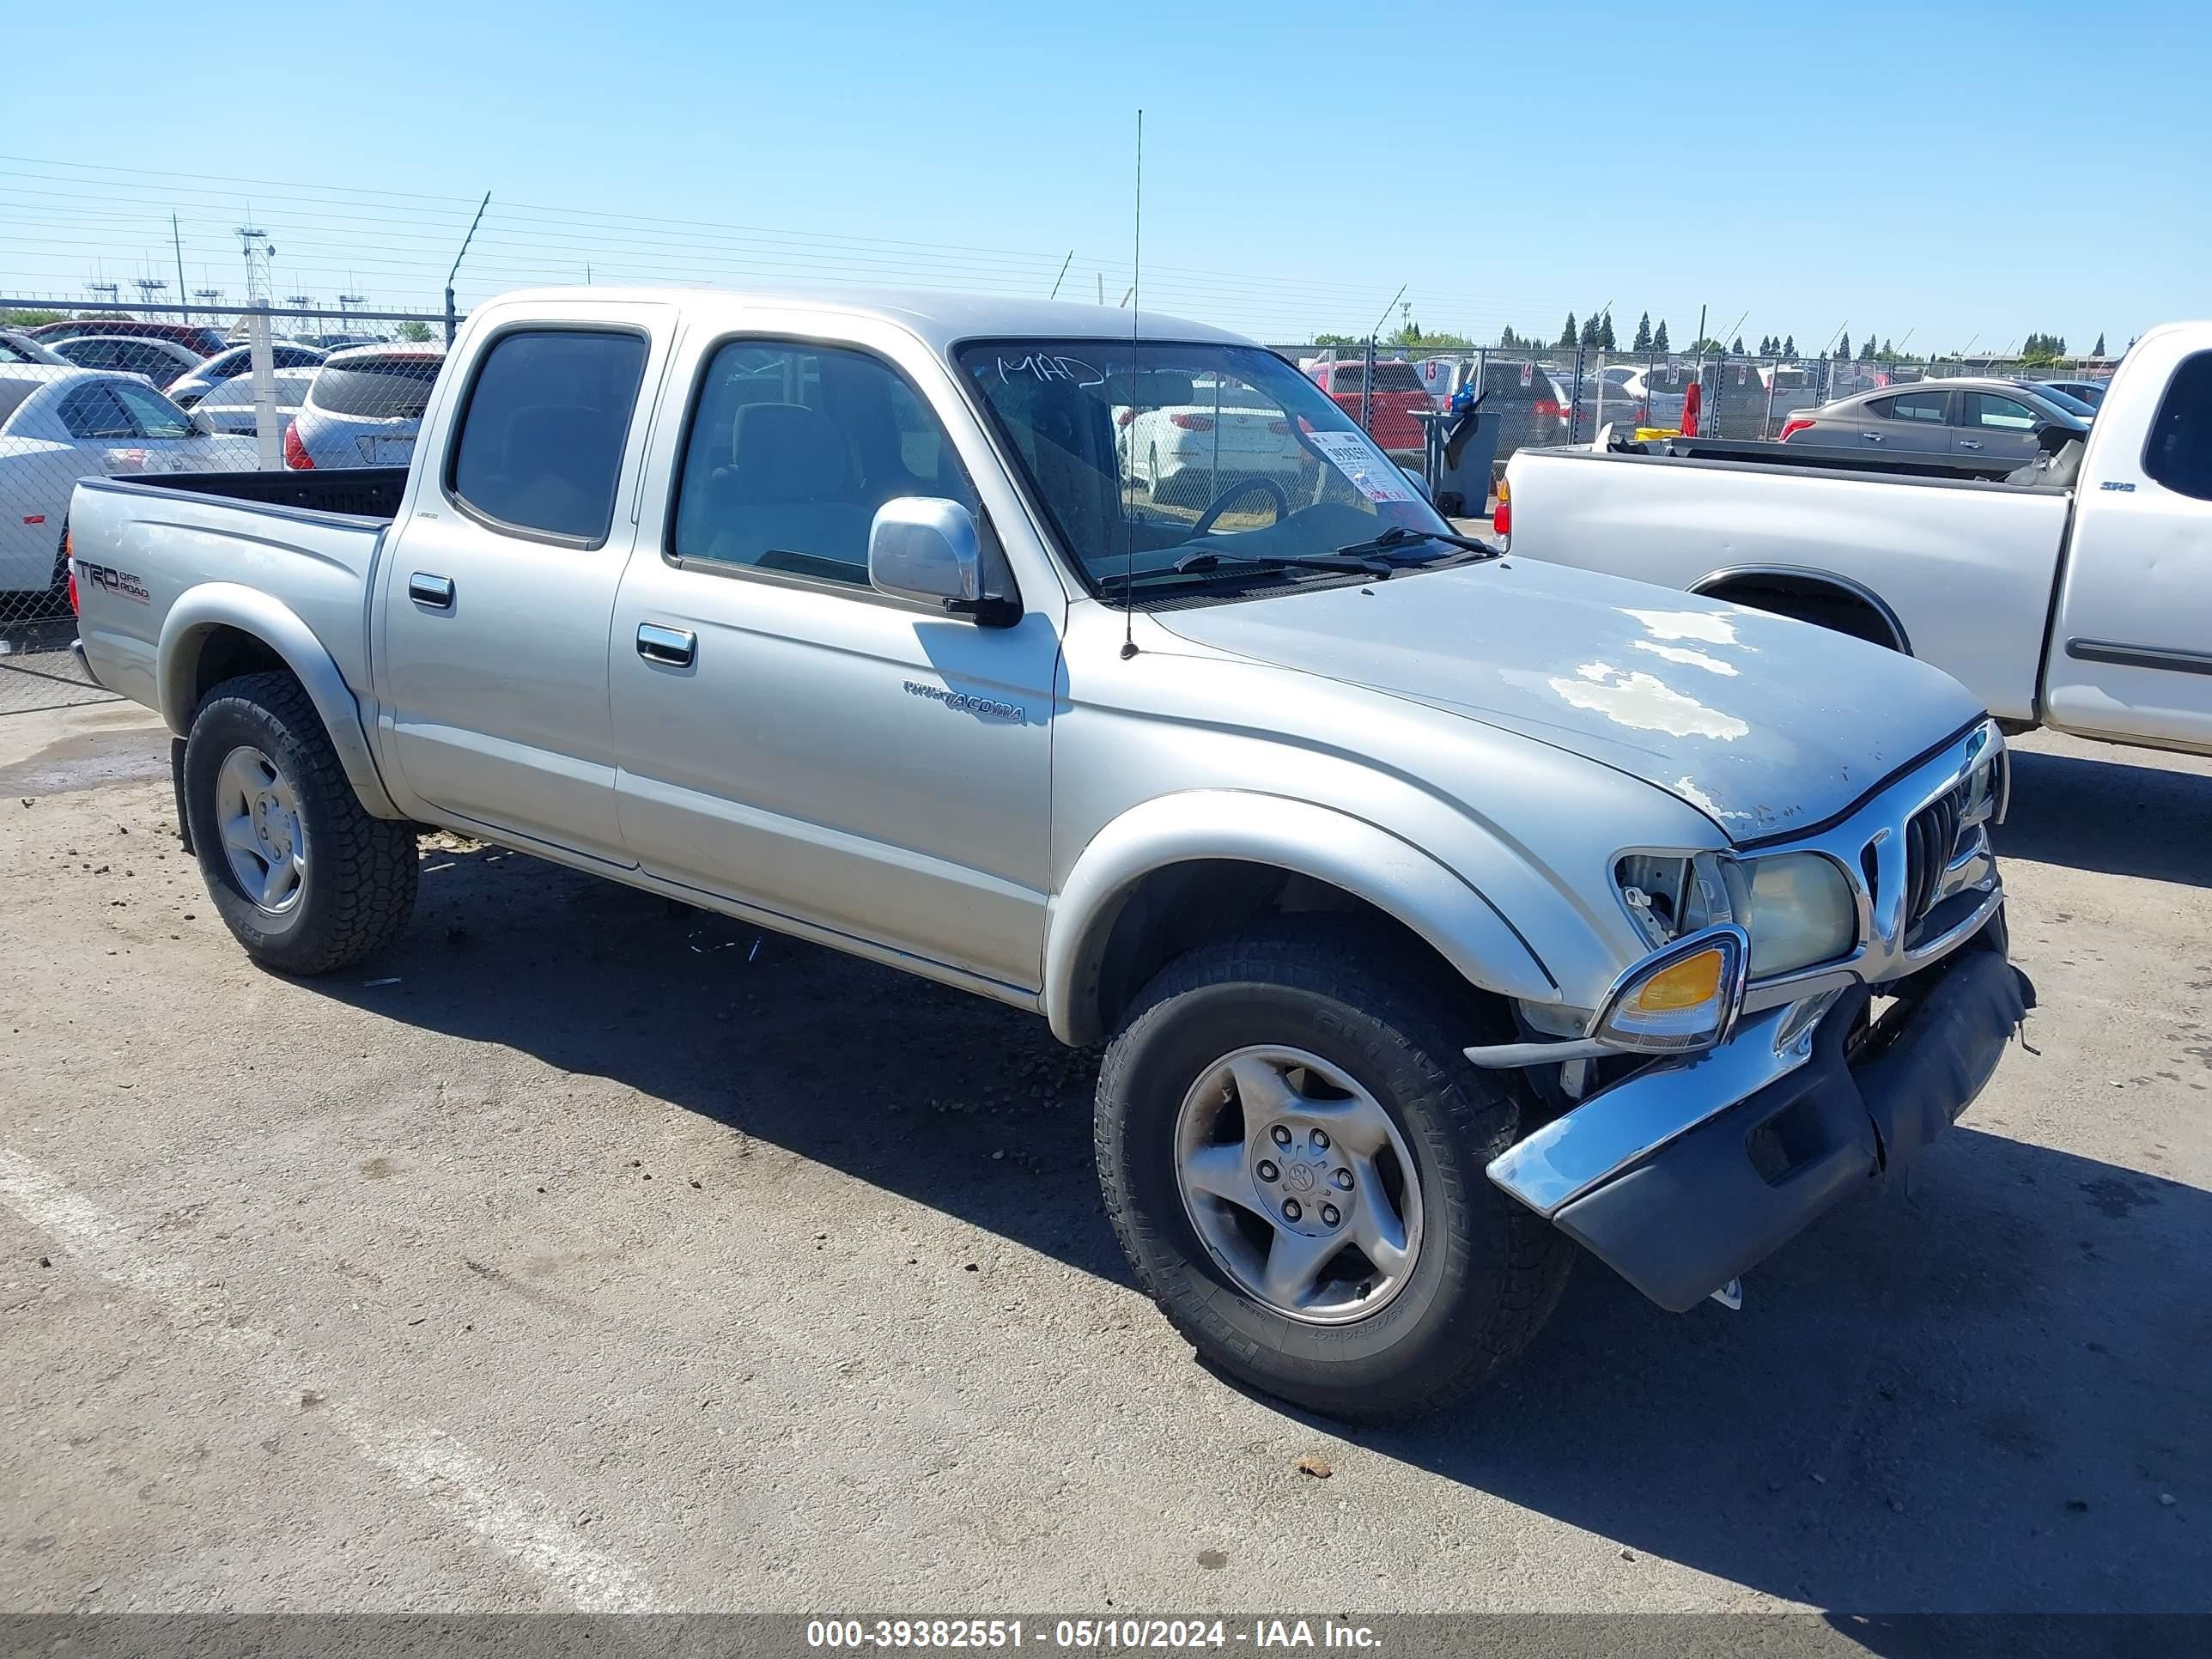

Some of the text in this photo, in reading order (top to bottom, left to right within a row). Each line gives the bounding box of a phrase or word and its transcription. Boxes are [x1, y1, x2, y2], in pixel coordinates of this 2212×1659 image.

[997, 352, 1105, 389] MAD
[1425, 361, 1437, 380] 13
[1522, 363, 1532, 380] 14
[75, 558, 120, 593] TRD
[119, 571, 142, 585] OFF
[120, 582, 149, 599] ROAD
[945, 691, 1026, 721] TACOMA
